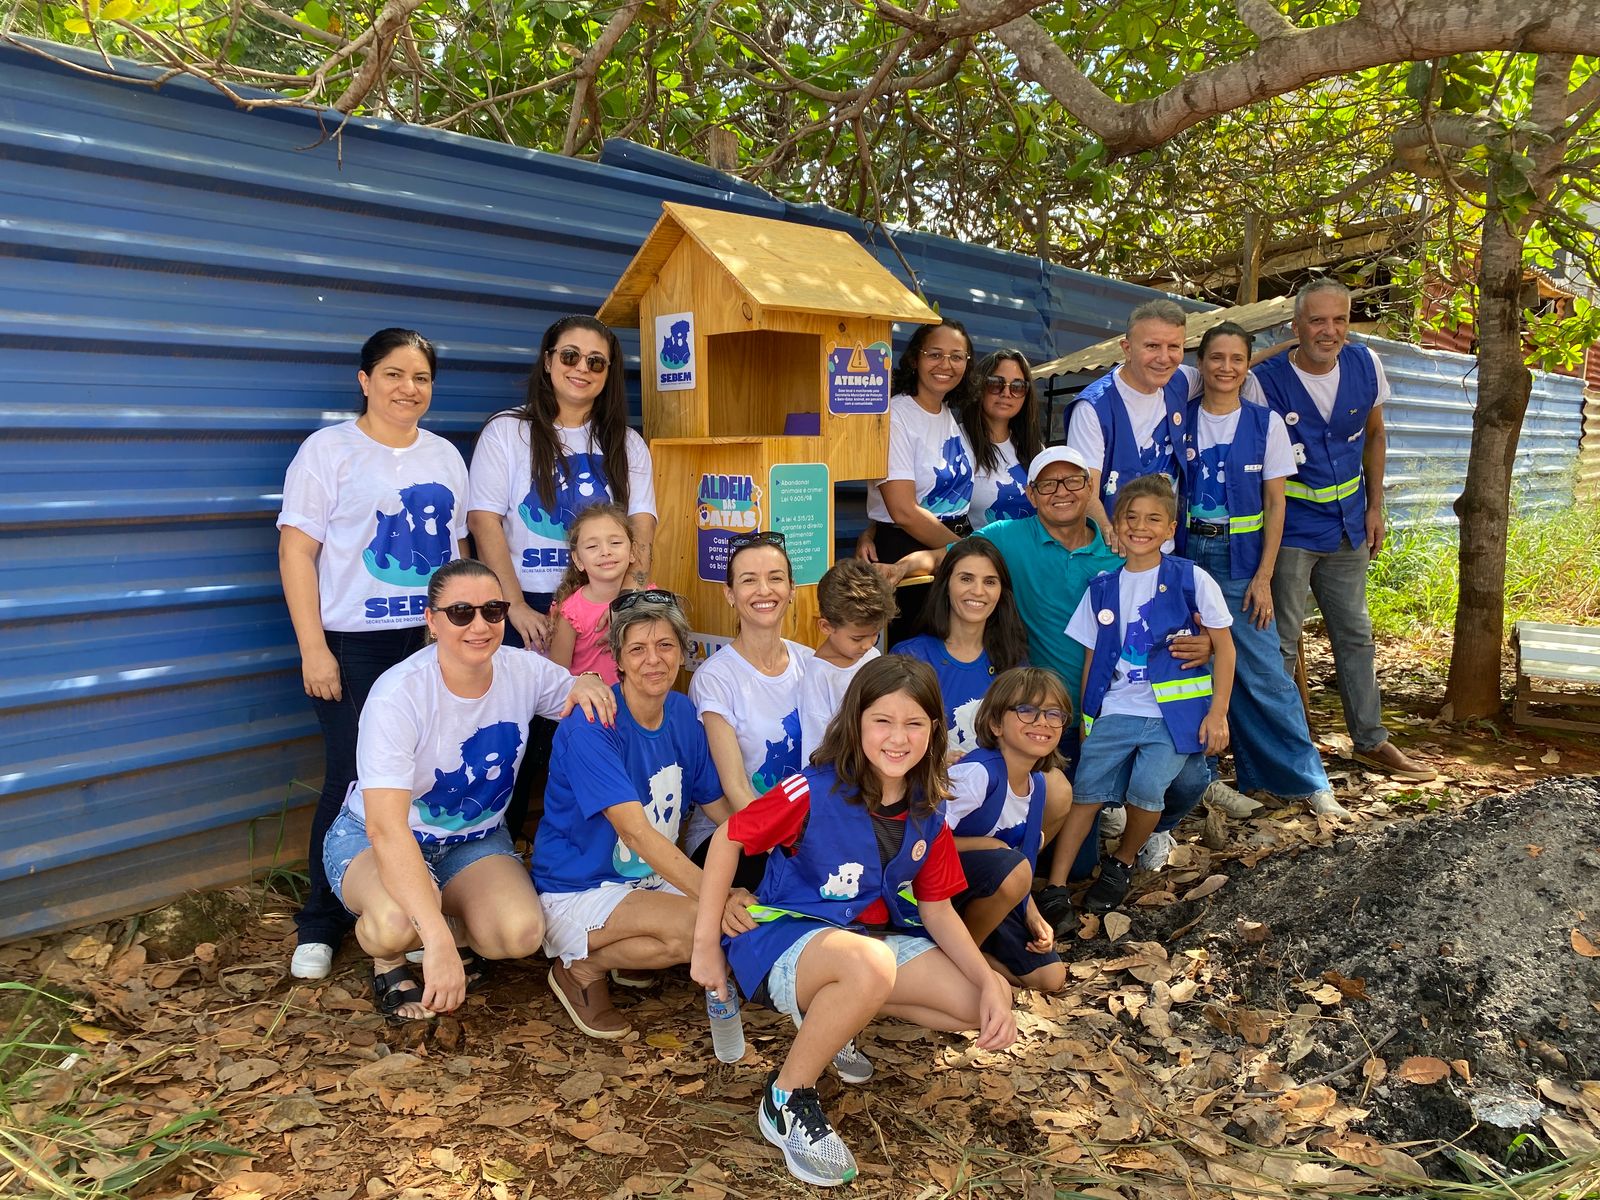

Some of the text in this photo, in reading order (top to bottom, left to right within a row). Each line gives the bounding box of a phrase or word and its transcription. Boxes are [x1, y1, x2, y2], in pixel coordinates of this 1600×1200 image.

[660, 372, 692, 383] SEBEM
[834, 374, 883, 387] ATENÇÃO
[701, 474, 753, 501] ALDEIA
[723, 499, 736, 510] DAS
[699, 510, 756, 527] PATAS
[781, 524, 802, 532] garante
[807, 522, 824, 530] direito
[789, 531, 814, 539] alimentar
[522, 548, 571, 568] SEB
[365, 595, 429, 618] SEB
